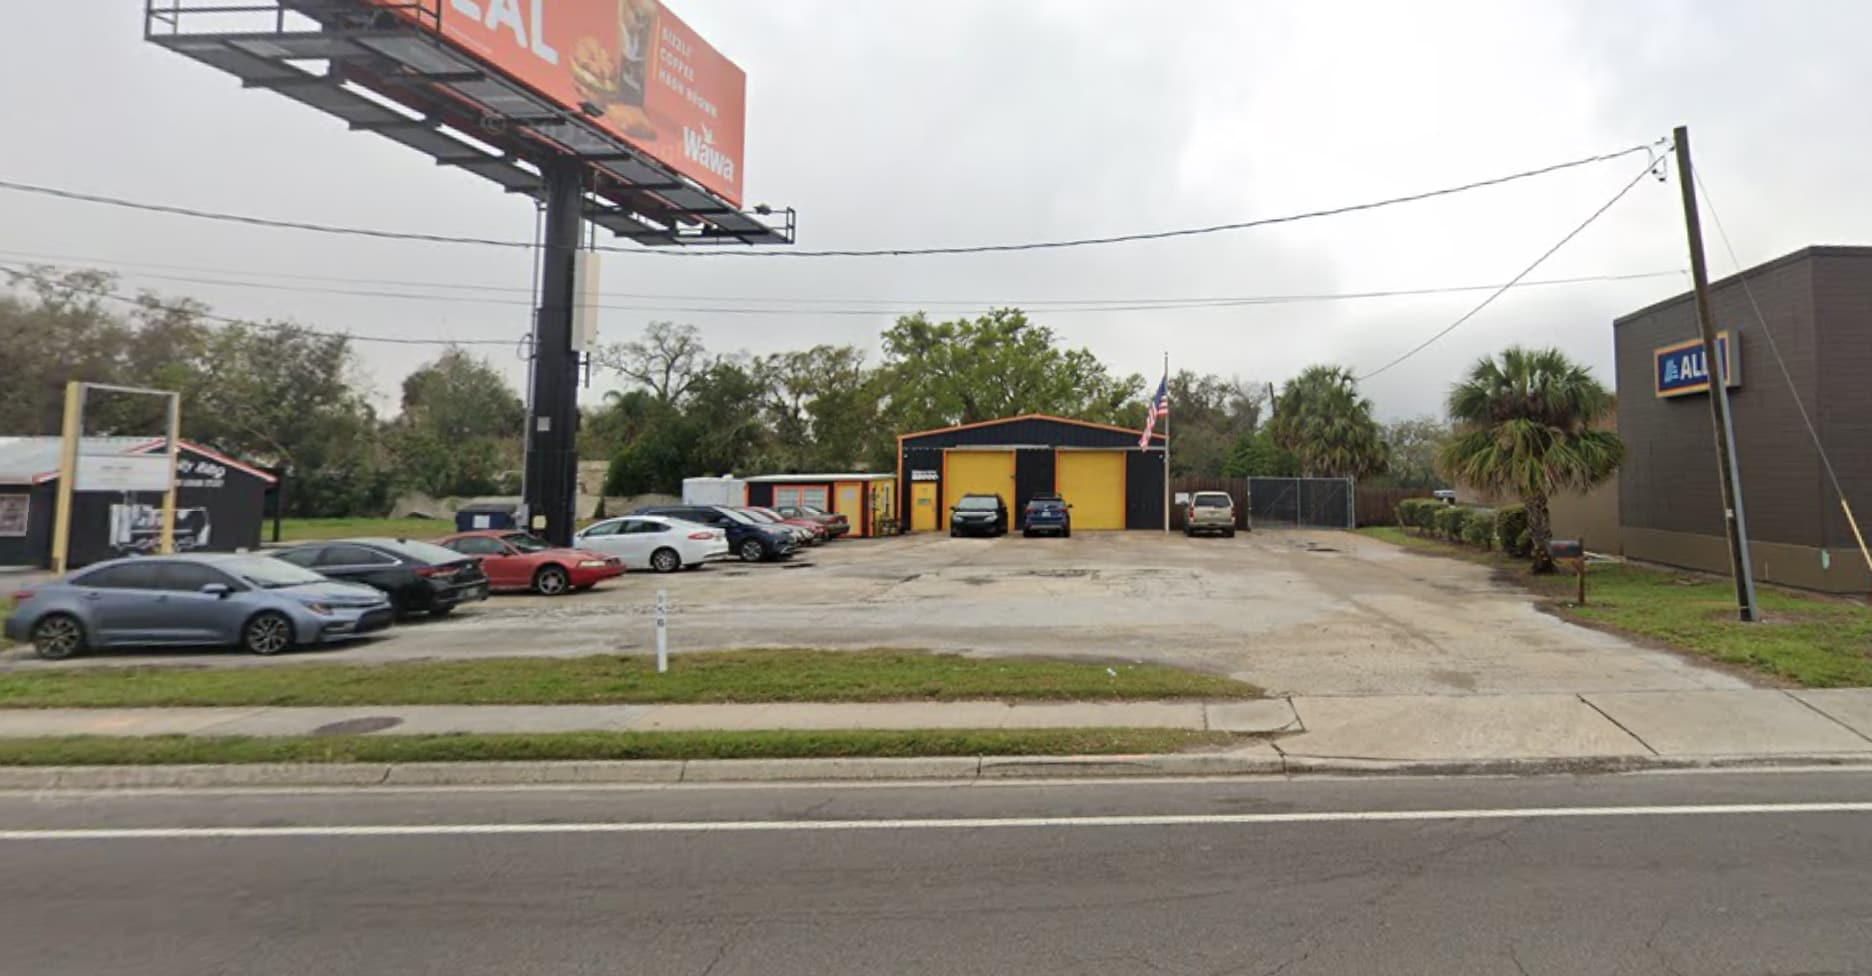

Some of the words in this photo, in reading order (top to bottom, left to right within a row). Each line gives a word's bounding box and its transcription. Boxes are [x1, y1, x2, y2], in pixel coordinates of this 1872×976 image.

[661, 47, 694, 81] COFFEE
[683, 125, 735, 183] Wawa
[1680, 350, 1712, 380] AL
